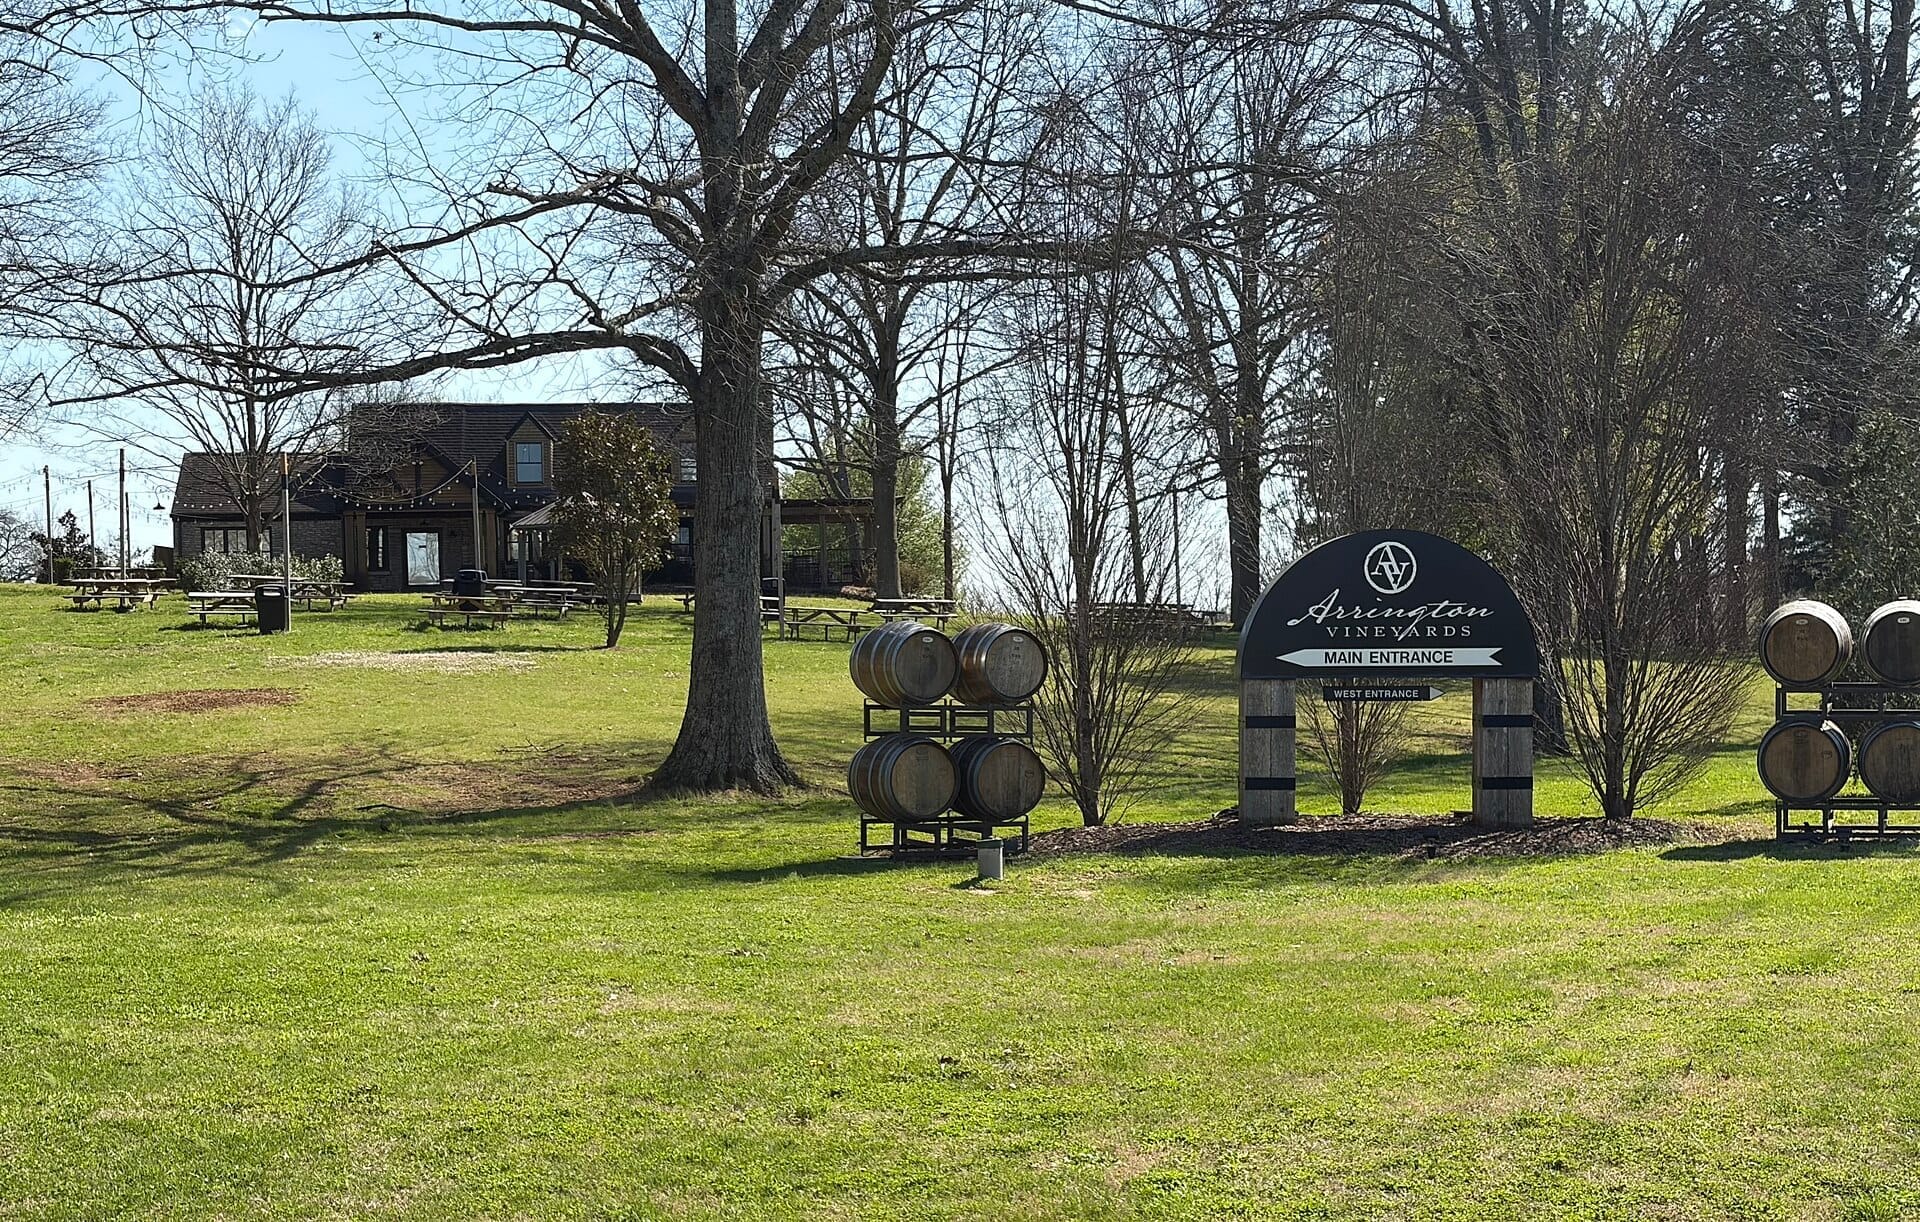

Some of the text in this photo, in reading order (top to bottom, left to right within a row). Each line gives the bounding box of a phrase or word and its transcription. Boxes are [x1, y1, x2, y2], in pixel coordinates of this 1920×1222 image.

[1287, 588, 1495, 641] Arrington
[1326, 625, 1471, 638] VINEYARDS
[1324, 650, 1454, 664] MAIN ENTRANCE
[1333, 689, 1419, 698] WEST ENTRANCE
